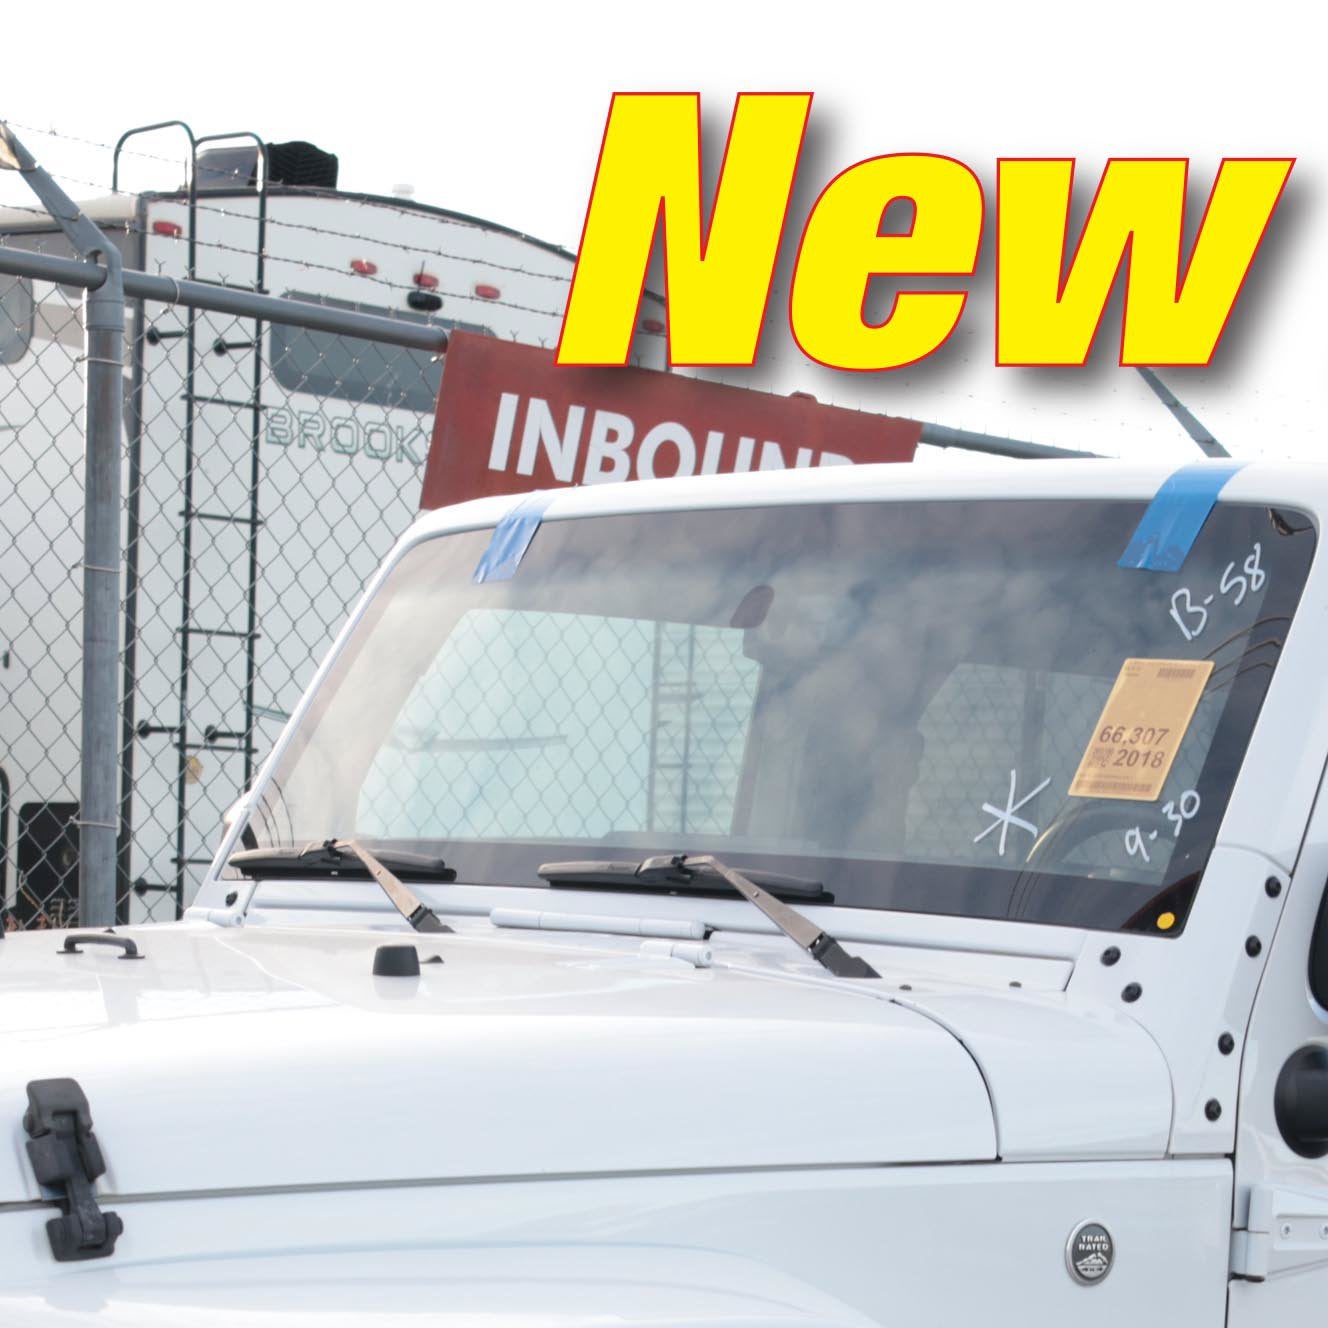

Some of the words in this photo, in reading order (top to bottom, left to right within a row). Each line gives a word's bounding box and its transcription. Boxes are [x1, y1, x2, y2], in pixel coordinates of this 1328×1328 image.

[1169, 542, 1266, 641] B-58
[1099, 725, 1170, 746] 66,307
[1113, 748, 1166, 769] 2018
[1078, 1242, 1109, 1251] RATED
